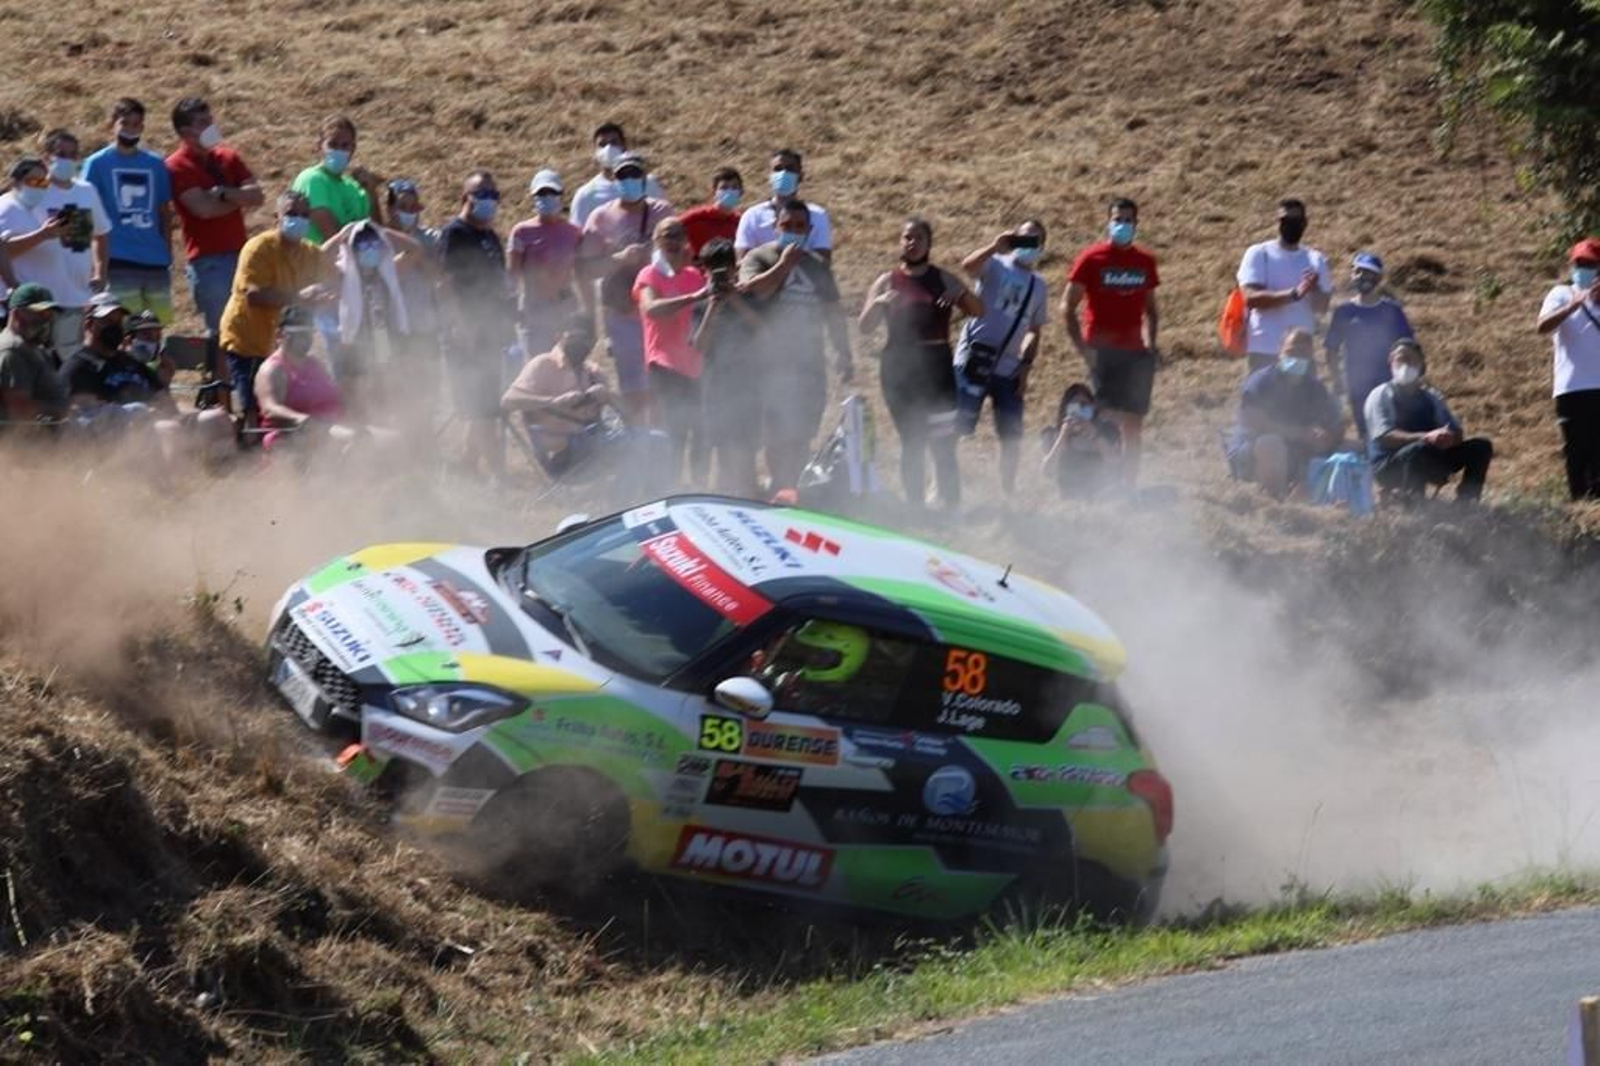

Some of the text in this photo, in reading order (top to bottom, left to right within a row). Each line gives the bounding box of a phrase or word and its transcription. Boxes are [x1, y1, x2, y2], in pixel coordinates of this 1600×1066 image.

[650, 534, 708, 578] Suzuki
[319, 609, 372, 664] SUZUKI
[943, 648, 987, 695] 58
[701, 718, 740, 751] 58
[676, 831, 825, 886] MOTUL
